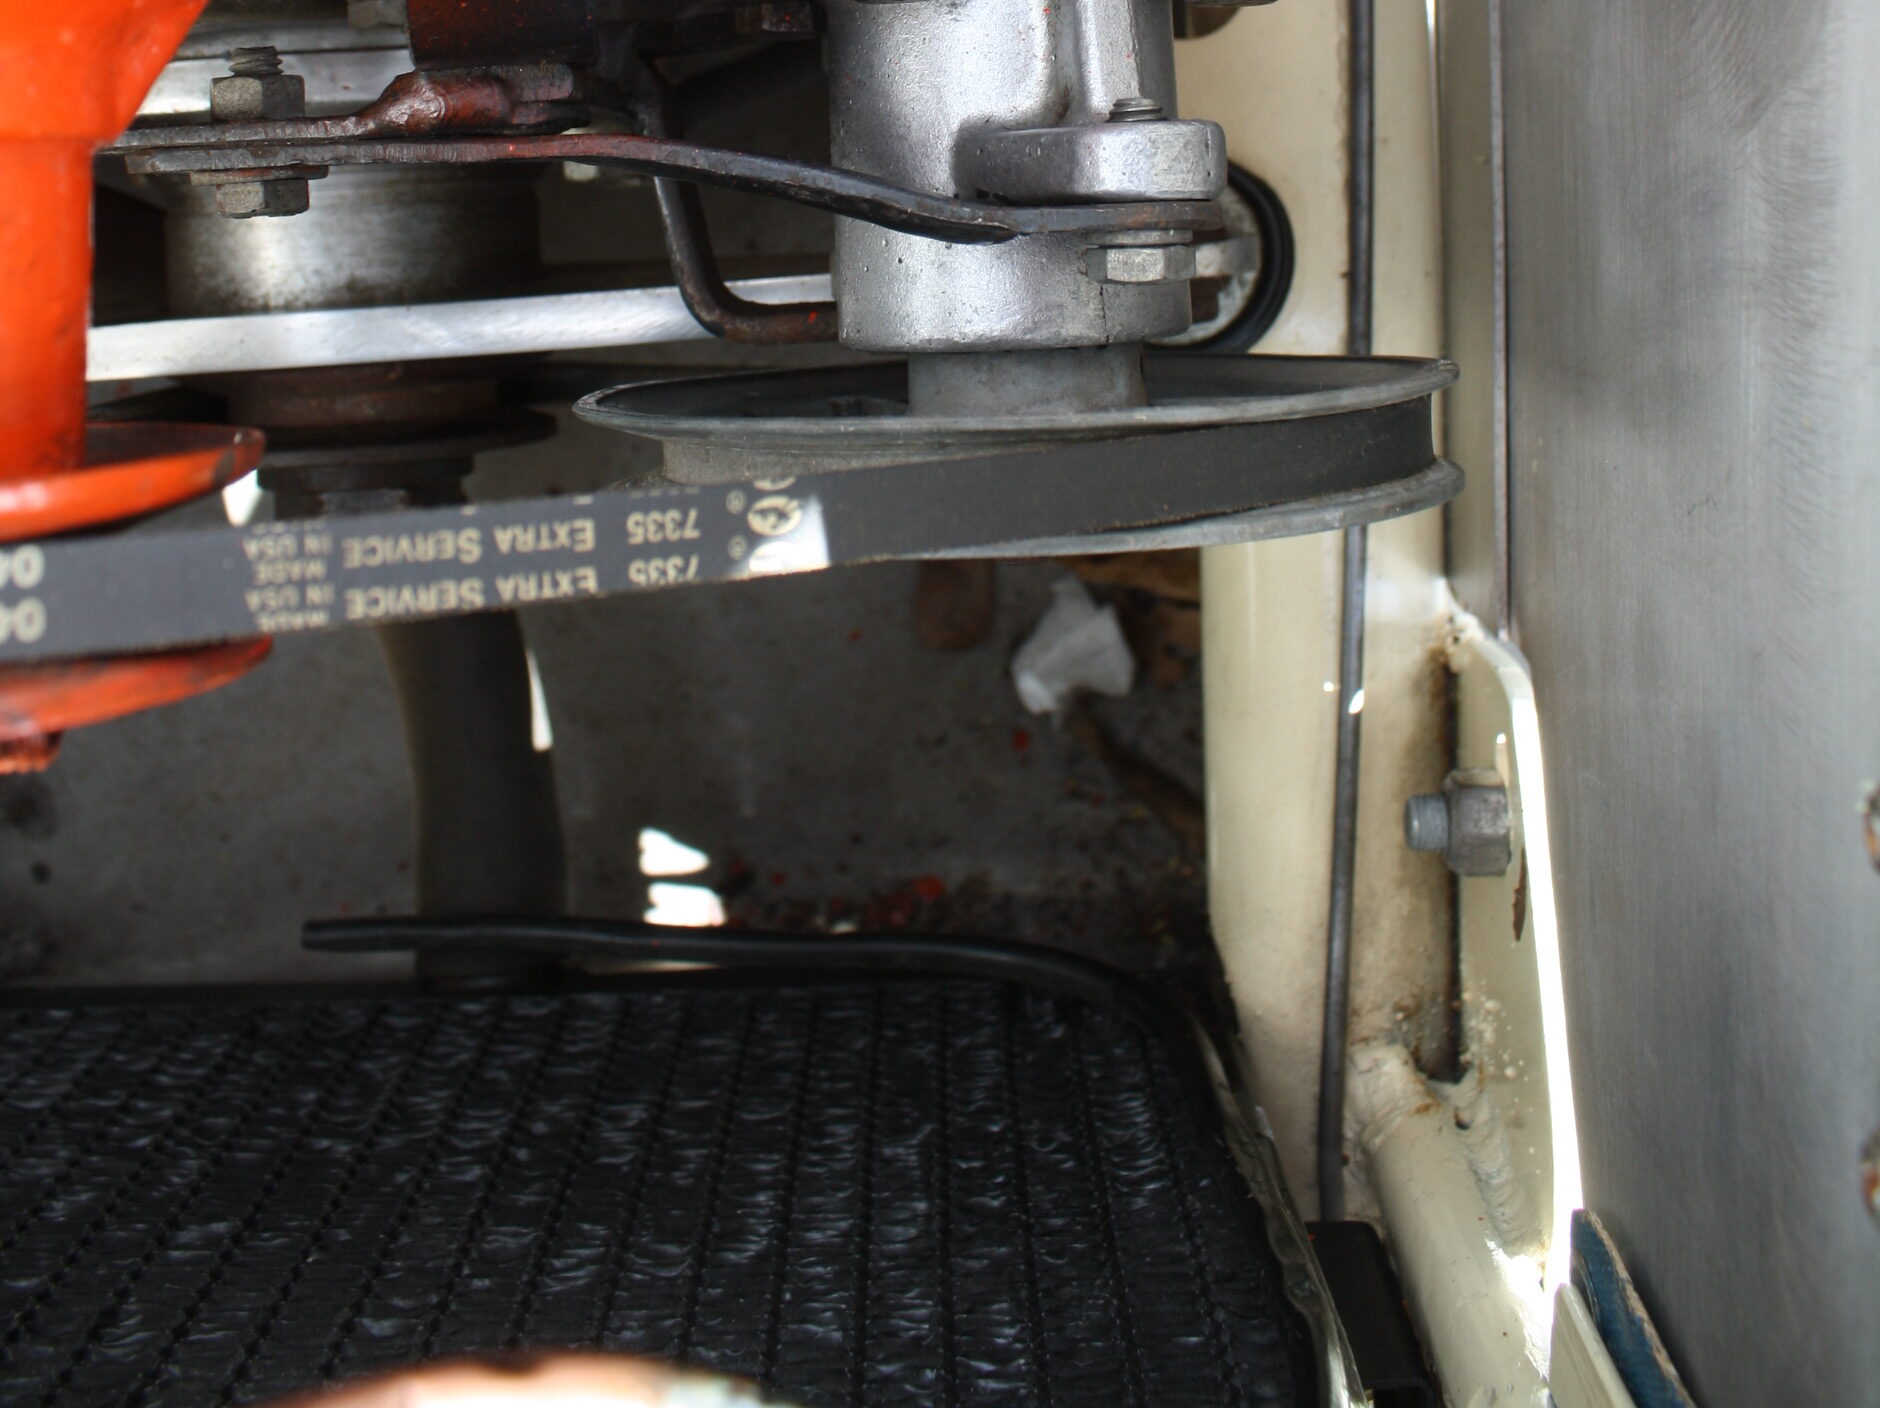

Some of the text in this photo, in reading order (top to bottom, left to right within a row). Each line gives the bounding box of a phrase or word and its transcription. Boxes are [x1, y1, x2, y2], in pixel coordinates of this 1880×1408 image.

[242, 532, 297, 561] USA
[341, 507, 700, 569] 7335 EXTRA SERVICE
[253, 559, 327, 585] MADE
[496, 566, 599, 602] EXTRA
[244, 584, 299, 613] USA
[344, 577, 486, 621] SERVICE
